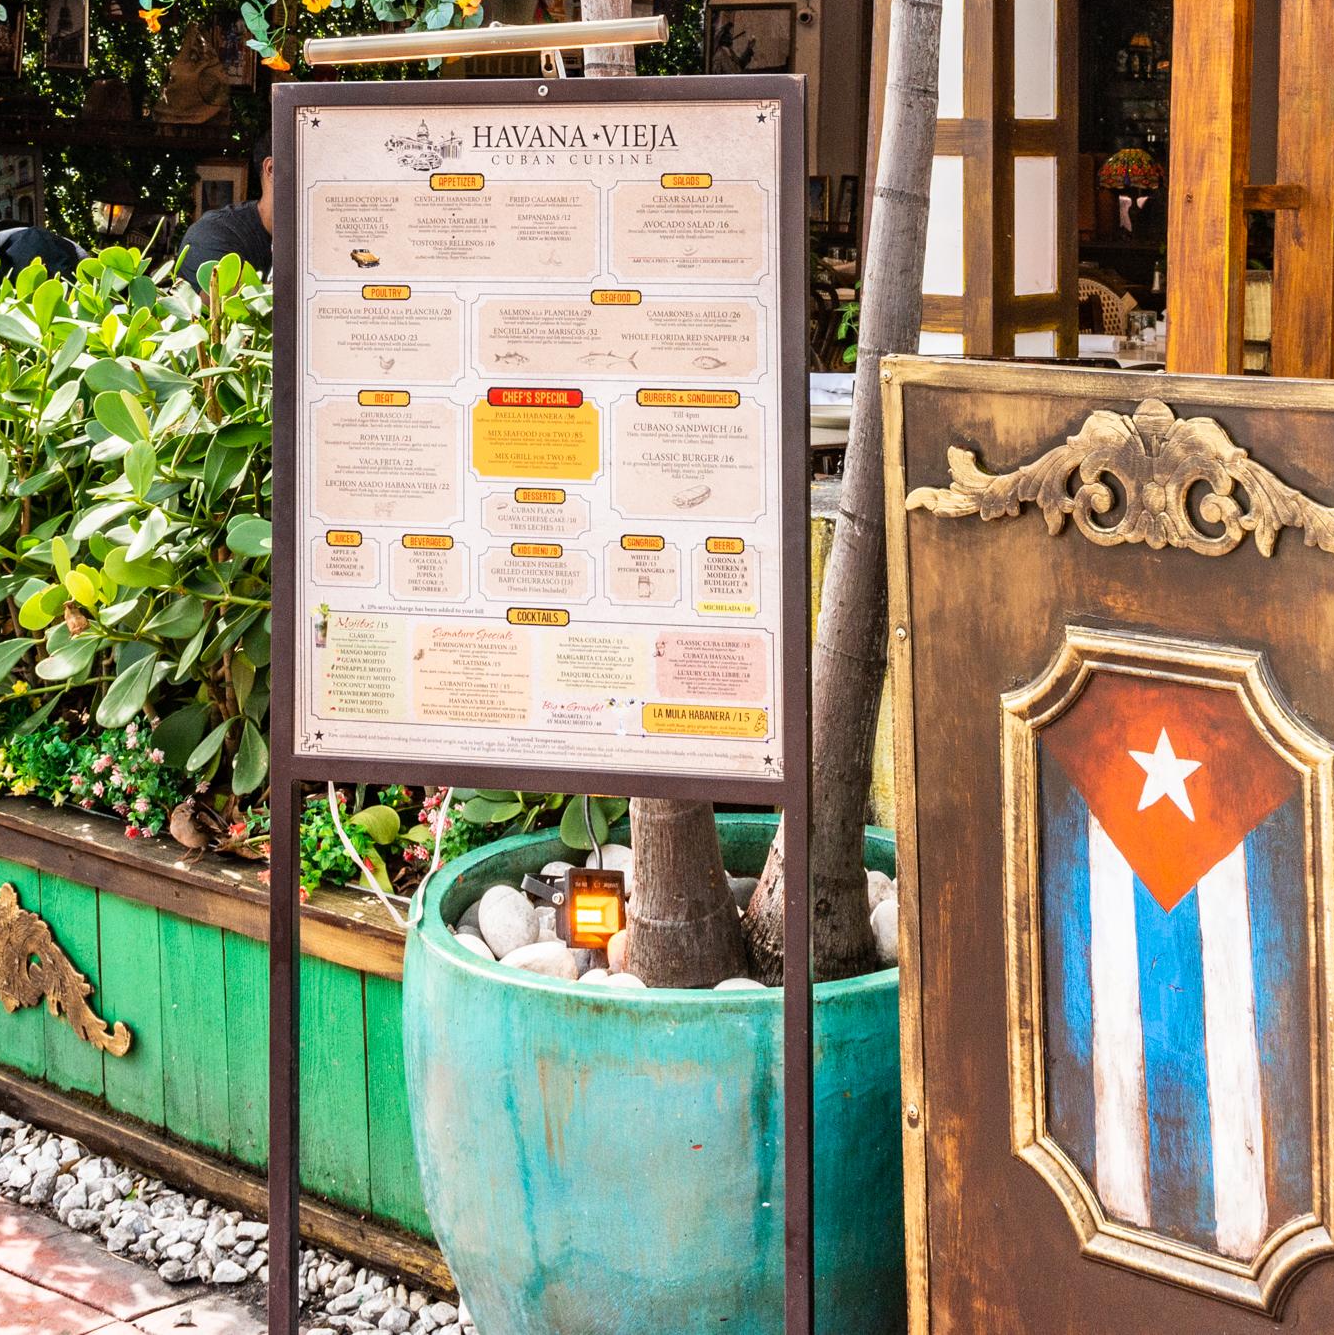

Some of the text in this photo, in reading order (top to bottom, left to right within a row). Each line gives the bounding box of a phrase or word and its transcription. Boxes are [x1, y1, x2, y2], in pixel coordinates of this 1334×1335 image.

[473, 124, 678, 151] HAVANA VIEJA
[491, 154, 653, 165] CUBAN CUISINE
[439, 177, 476, 187] APPETIZER
[673, 176, 700, 186] SALADS
[642, 221, 729, 229] AVOCADO SALAD /16
[371, 288, 402, 298] POULTRY
[600, 293, 631, 303] SEAFOOD
[318, 307, 353, 315] PECHUGA
[363, 307, 390, 315] POLLO
[646, 310, 694, 318] CAMARONES
[375, 393, 394, 403] MEAT
[502, 391, 569, 404] CHEF'S SPECIAL
[644, 393, 676, 403] BURGERS
[687, 394, 732, 404] SANDWICHES
[633, 423, 673, 432] CUBANO
[675, 424, 727, 433] SANDWICH
[360, 434, 401, 442] ROPA VIEJA
[642, 453, 680, 462] CLASSIC
[682, 454, 719, 462] BURGER
[325, 480, 358, 488] LECHON
[384, 481, 416, 489] HABANA
[523, 492, 556, 501] DESSERTS
[334, 535, 355, 543] JUICES
[410, 538, 447, 546] BEVERAGES
[627, 537, 660, 547] SANGRIAS
[714, 541, 735, 551] BEERS
[556, 570, 580, 578] BREAST
[517, 577, 560, 585] CHURRASCO
[517, 611, 559, 623] COCKTAILS
[653, 708, 663, 719] LA
[666, 708, 686, 719] MULA
[689, 709, 730, 722] HABANERA
